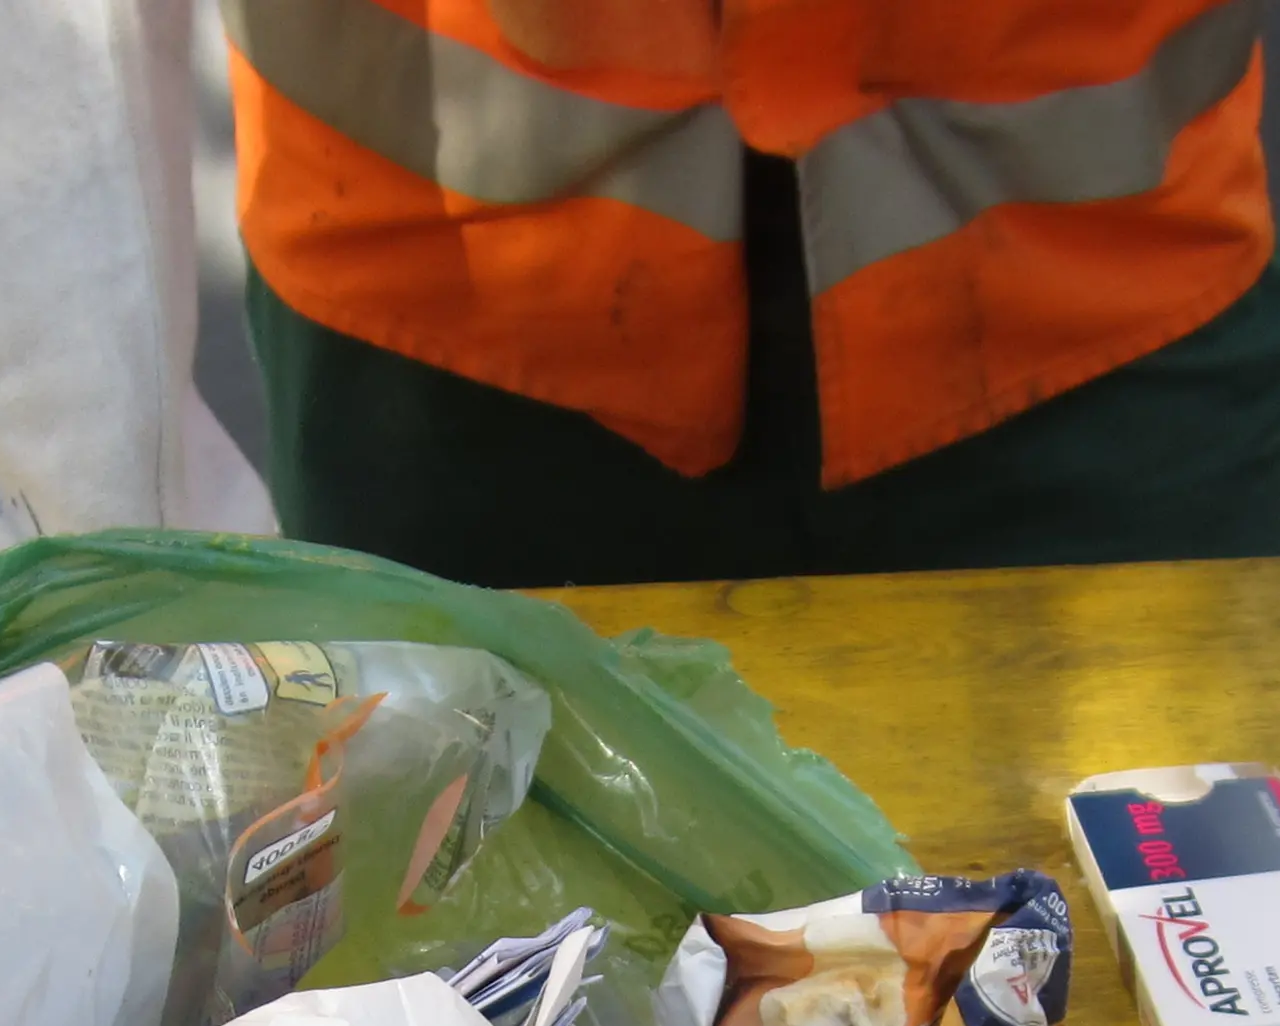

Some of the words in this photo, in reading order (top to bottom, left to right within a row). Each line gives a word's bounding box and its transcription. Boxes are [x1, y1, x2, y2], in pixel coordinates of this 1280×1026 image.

[1126, 801, 1165, 834] mg
[1137, 840, 1187, 881] 300
[1150, 886, 1249, 1017] APROVEL
